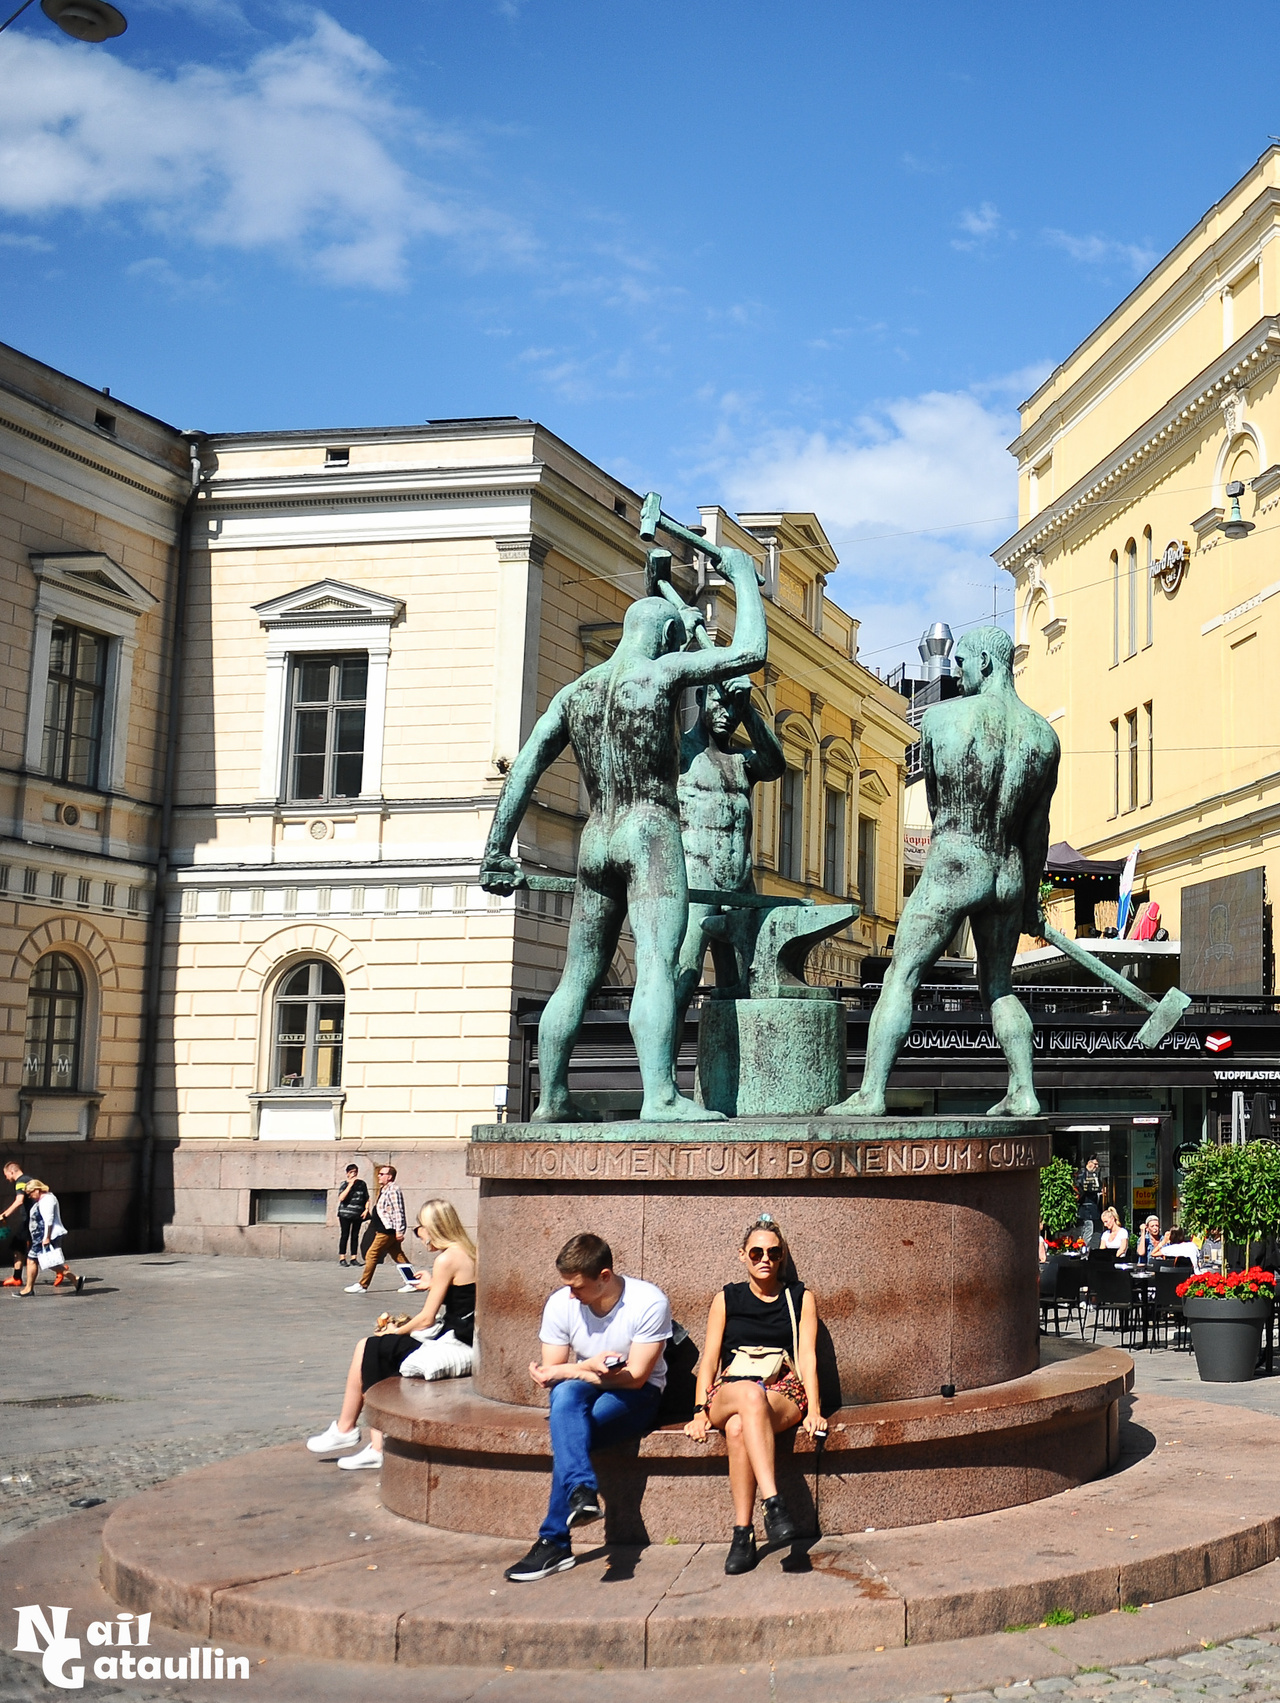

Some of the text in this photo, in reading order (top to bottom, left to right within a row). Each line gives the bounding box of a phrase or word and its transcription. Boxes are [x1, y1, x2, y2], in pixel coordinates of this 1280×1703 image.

[904, 1030, 1201, 1054] OMALAN KIRJAKAPPA
[26, 1057, 38, 1072] M
[57, 1058, 69, 1073] M
[521, 1146, 760, 1176] MONUMENTUM
[786, 1143, 972, 1175] PONENDUM
